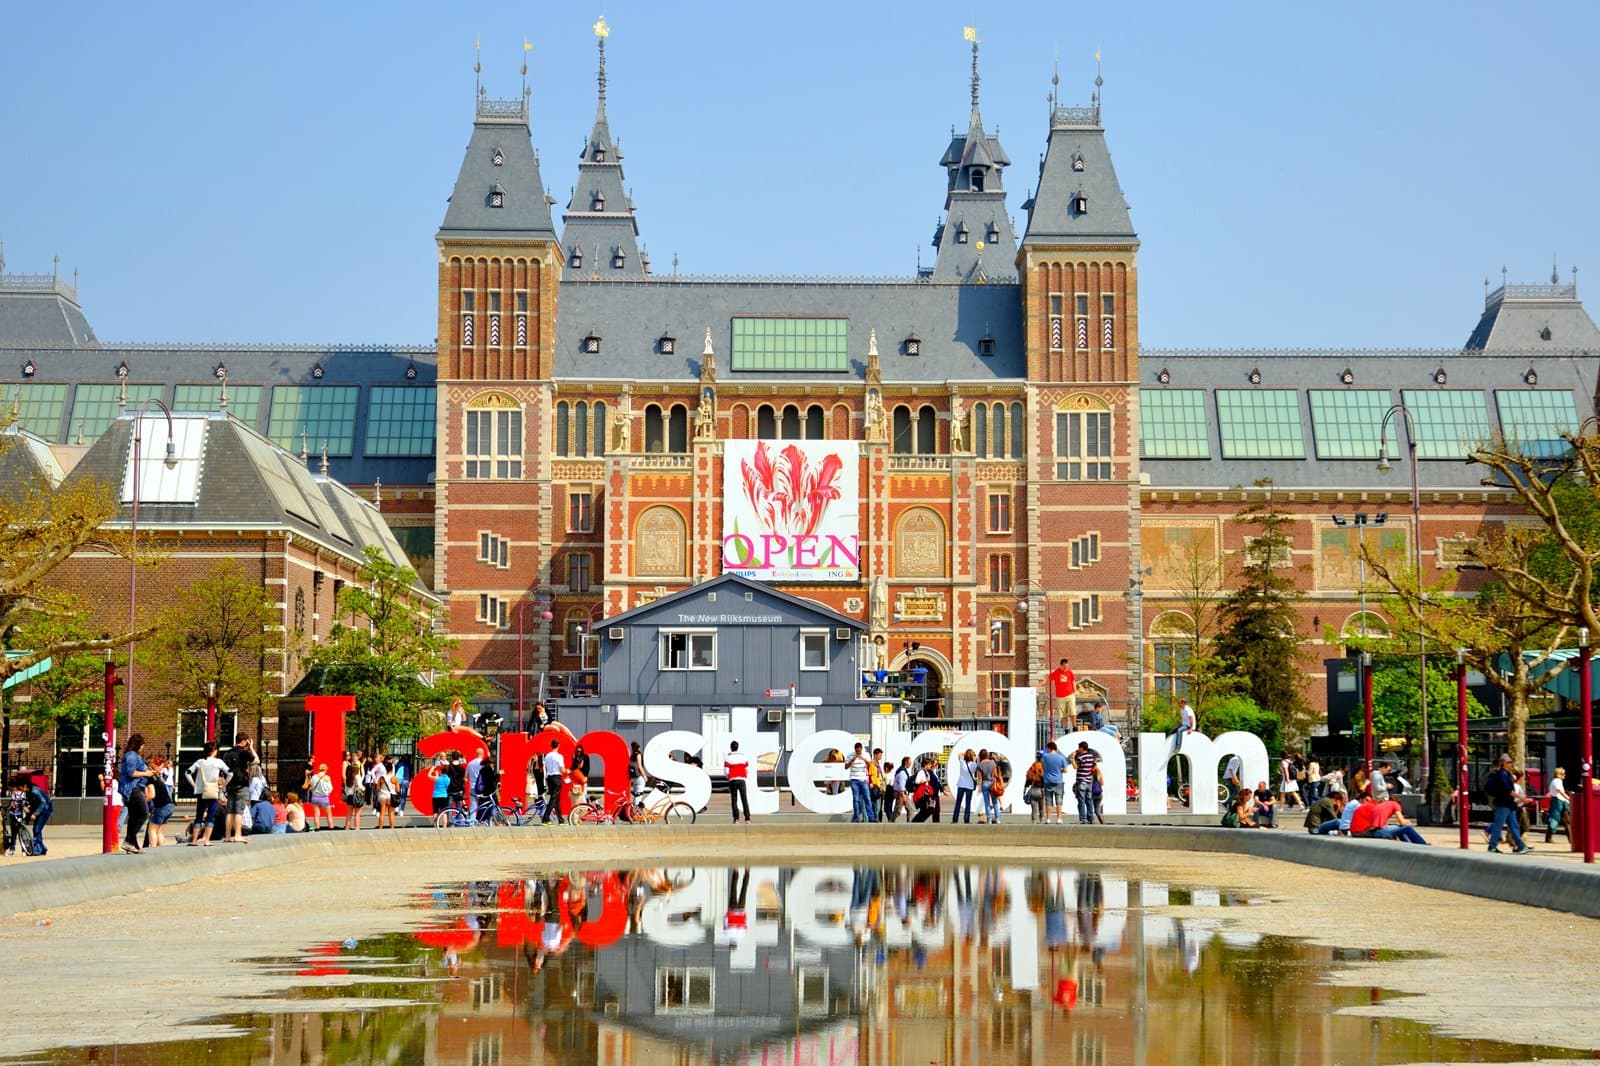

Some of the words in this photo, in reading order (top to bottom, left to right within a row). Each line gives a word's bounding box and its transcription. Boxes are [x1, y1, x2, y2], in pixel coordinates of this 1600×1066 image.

[724, 533, 858, 569] OPEN
[678, 614, 696, 623] The
[697, 614, 718, 623] New
[720, 614, 782, 624] Rijksmuseum
